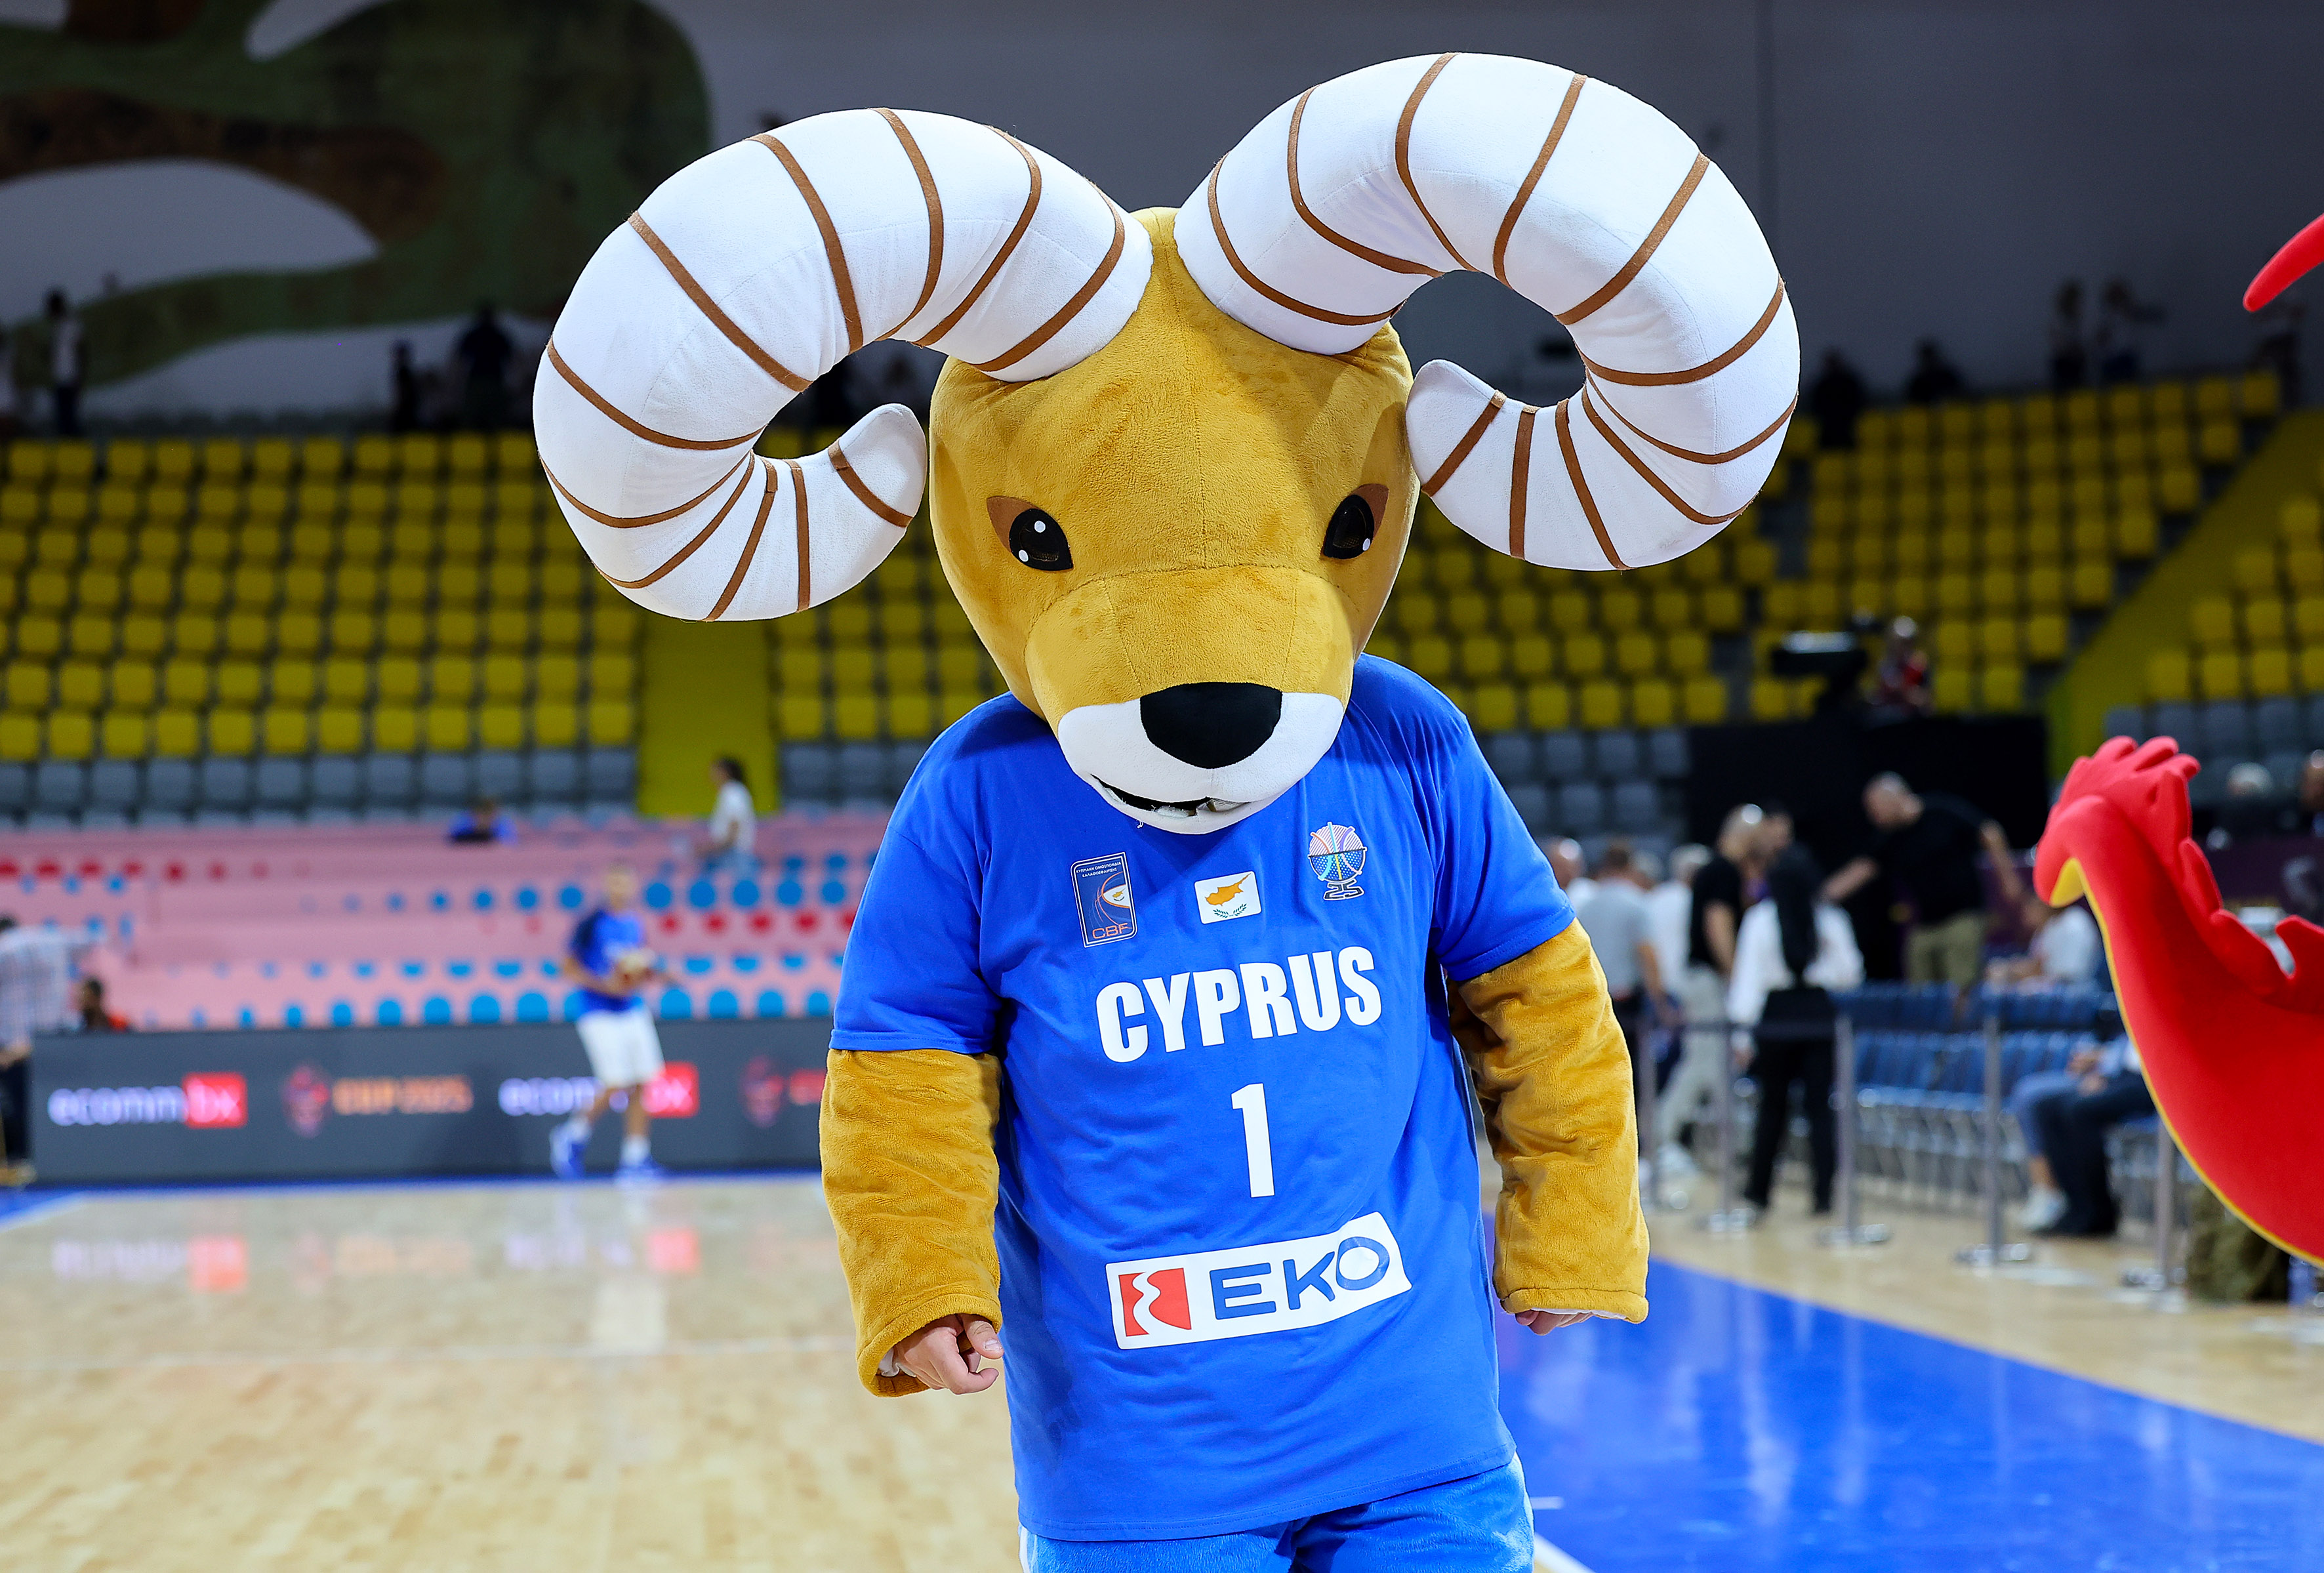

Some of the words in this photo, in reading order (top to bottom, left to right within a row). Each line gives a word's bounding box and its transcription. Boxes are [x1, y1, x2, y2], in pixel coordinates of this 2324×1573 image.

[1092, 922, 1128, 939] CBF
[1096, 946, 1381, 1063] CYPRUS
[47, 1080, 241, 1126] ecommbx
[1231, 1083, 1275, 1198] 1
[1209, 1236, 1390, 1320] EKO
